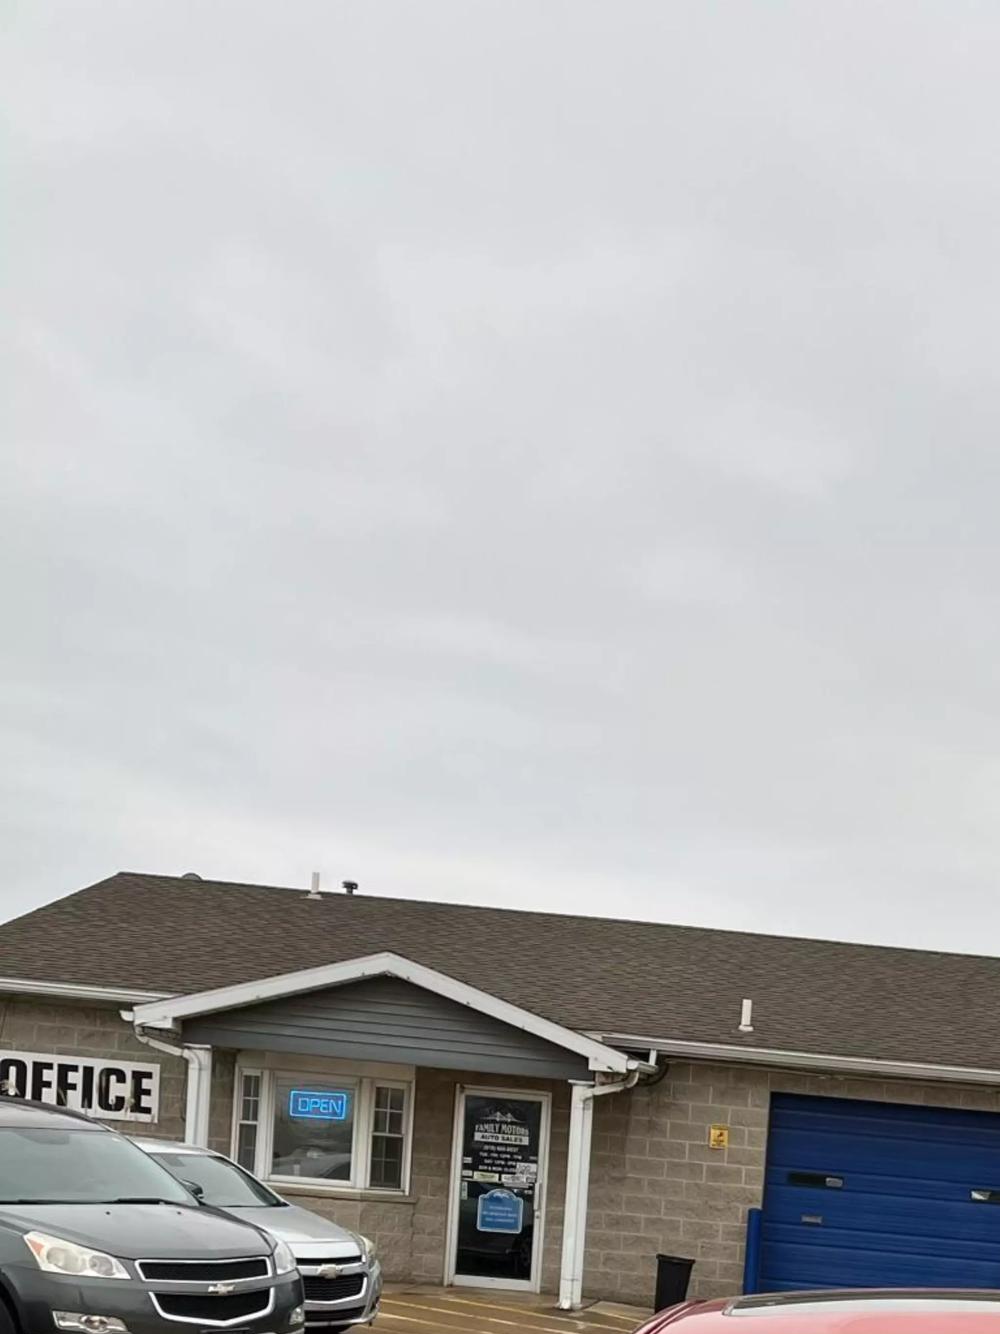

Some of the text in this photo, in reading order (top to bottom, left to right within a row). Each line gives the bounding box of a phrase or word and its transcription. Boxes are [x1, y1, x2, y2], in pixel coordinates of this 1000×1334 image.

[0, 1058, 153, 1115] OFFICE
[298, 1097, 342, 1113] OPEN
[475, 1123, 529, 1135] FAMILY MOTORS
